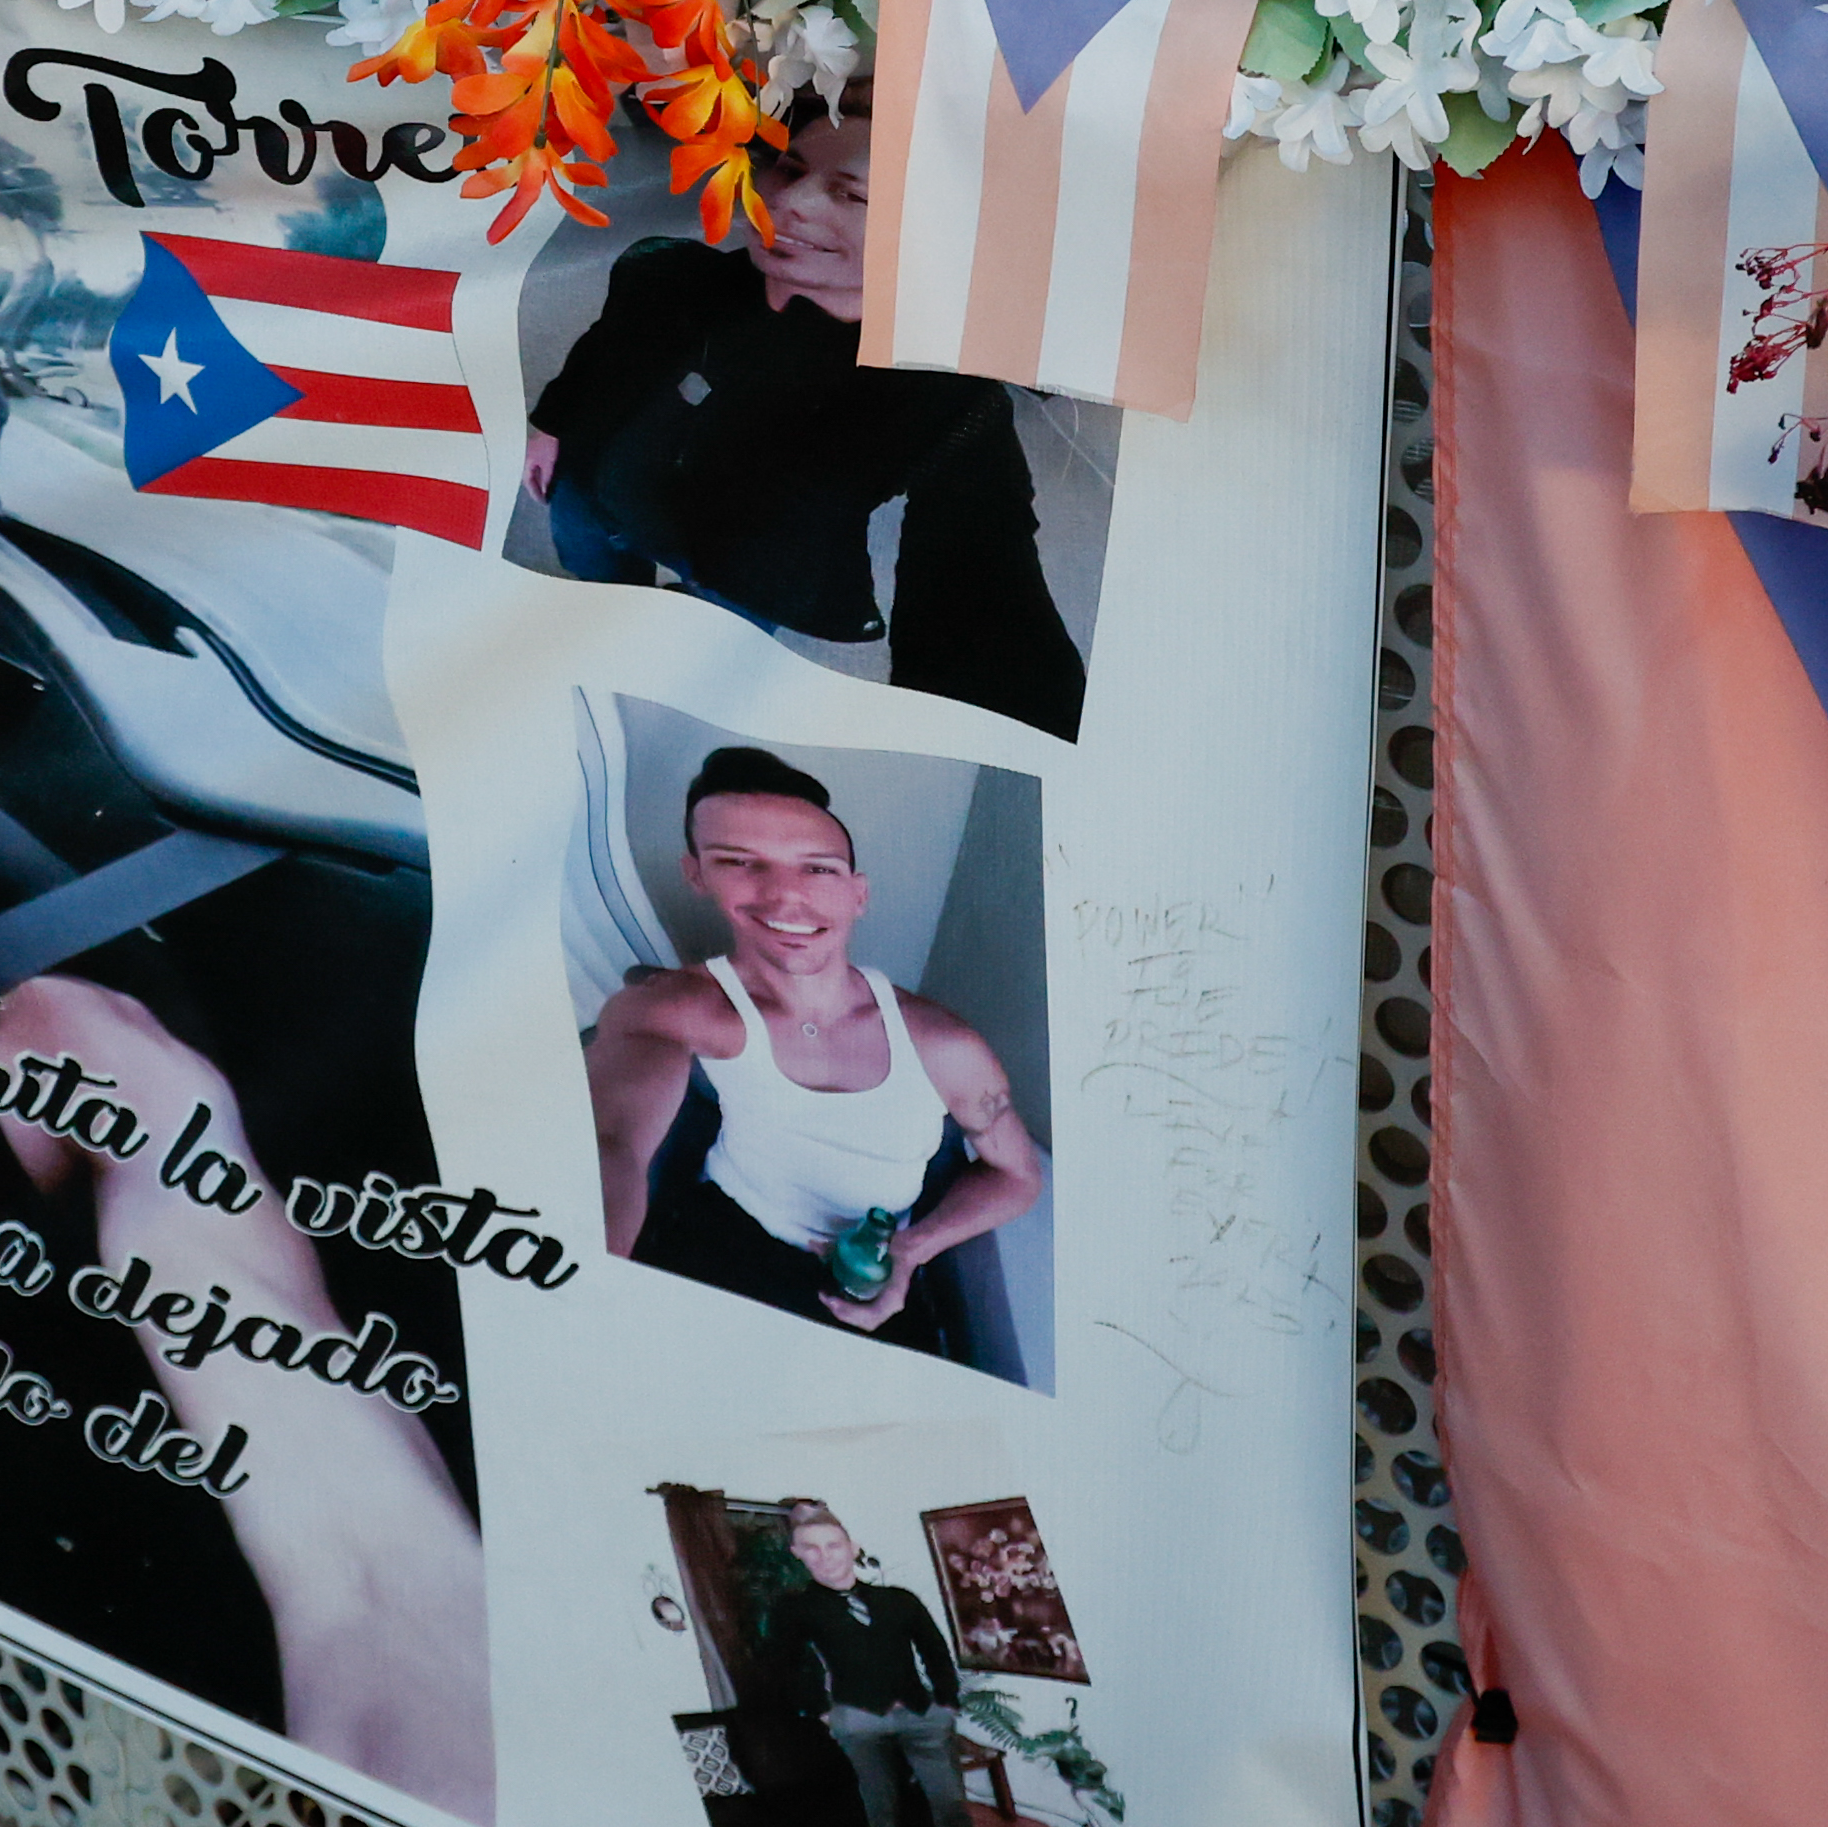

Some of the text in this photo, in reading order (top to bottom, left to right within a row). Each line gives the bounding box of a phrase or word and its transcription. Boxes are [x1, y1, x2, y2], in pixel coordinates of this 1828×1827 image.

[3, 48, 485, 207] Torre
[159, 1098, 263, 1215] la
[284, 1172, 579, 1290] vista
[68, 1254, 460, 1413] dejado
[85, 1388, 252, 1498] del
